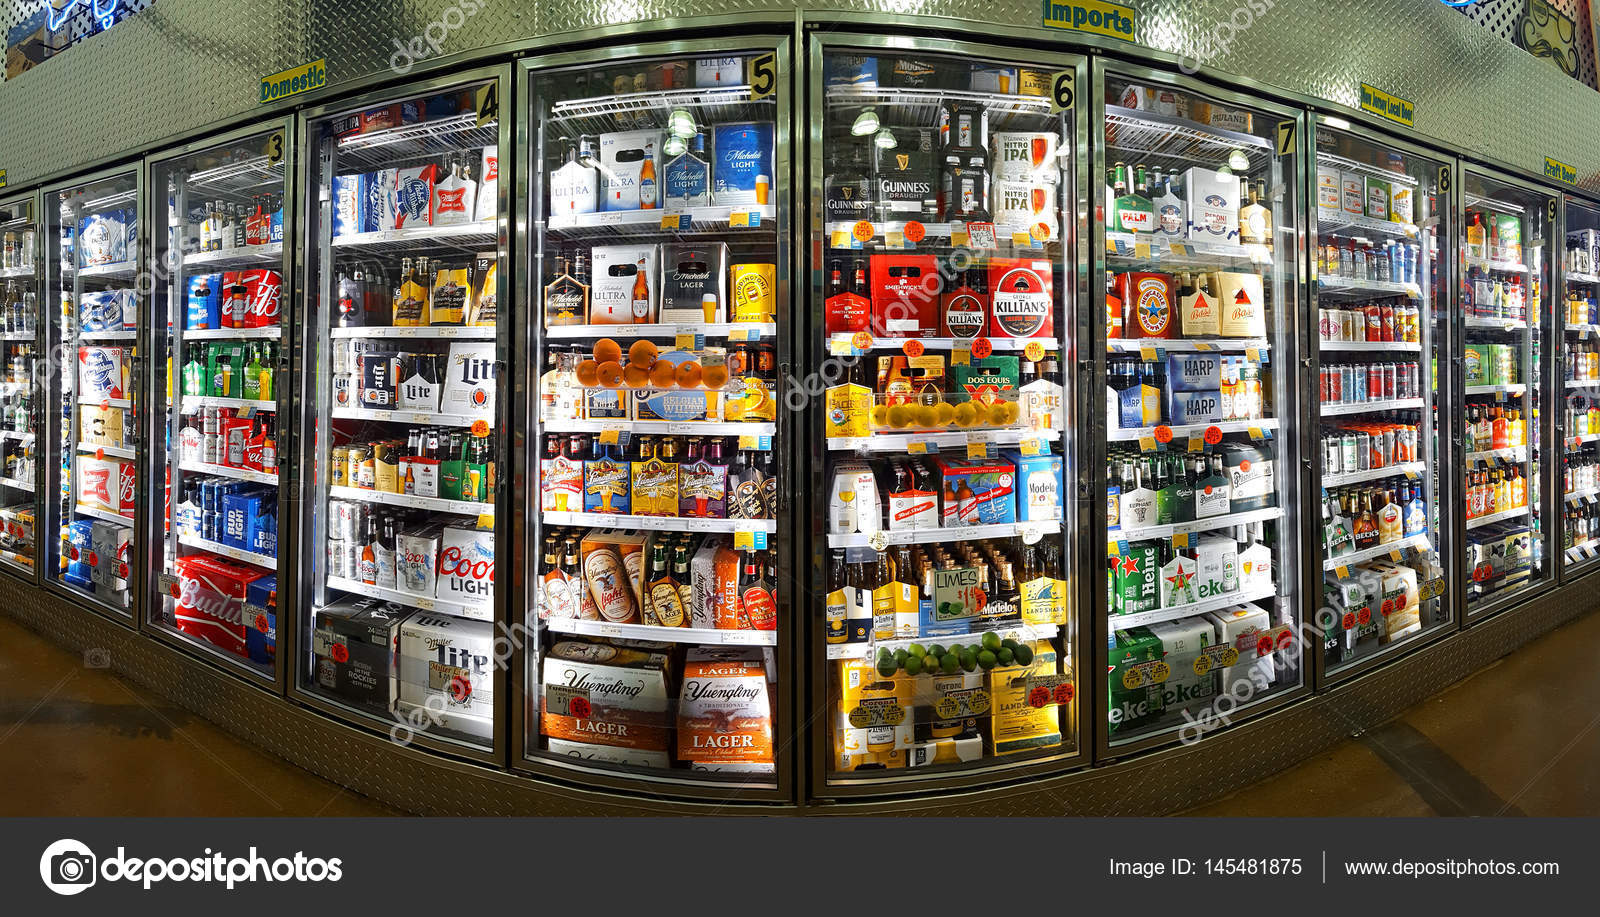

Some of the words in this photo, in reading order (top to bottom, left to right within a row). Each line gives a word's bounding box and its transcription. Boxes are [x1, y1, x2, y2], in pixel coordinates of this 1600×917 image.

[1045, 0, 1133, 35] Imports
[754, 53, 775, 94] 5
[260, 65, 325, 101] Domestic
[1053, 74, 1073, 108] 6
[479, 84, 499, 120] 4
[1279, 123, 1296, 154] 7
[269, 134, 283, 162] 3
[724, 149, 763, 161] Michelob
[1004, 149, 1029, 162] IPA
[667, 170, 705, 182] Michelob
[1545, 161, 1561, 180] Craft
[602, 178, 635, 188] ULTRA
[1439, 167, 1451, 192] 8
[881, 180, 930, 194] GUINNESS
[828, 199, 867, 210] GUINNESS
[1004, 198, 1029, 211] IPA
[1549, 199, 1557, 220] 9
[1122, 213, 1147, 222] PALM
[477, 259, 488, 268] 12
[673, 271, 712, 281] Michelob
[594, 292, 627, 300] ULTRA
[664, 298, 673, 306] 12
[1141, 290, 1166, 306] NEWCASTLE
[996, 301, 1047, 313] KILLIAN'S
[948, 315, 983, 324] KILLIAN'S
[881, 358, 889, 366] 12
[1184, 360, 1214, 376] HARP
[967, 376, 985, 384] DOS
[987, 376, 1011, 384] EQUIS
[406, 384, 431, 401] Lite
[663, 396, 705, 405] BELGIAN
[1186, 399, 1216, 416] HARP
[227, 510, 236, 535] BUD
[234, 508, 244, 541] LIGHT
[258, 531, 276, 544] BUD
[1355, 528, 1380, 541] BECK'S
[937, 570, 978, 588] LIMES
[726, 580, 736, 620] LAGER
[982, 602, 1013, 615] Modelo
[416, 616, 451, 628] Lite
[367, 626, 375, 634] 24
[1174, 640, 1185, 650] 12
[348, 670, 377, 686] ROCKIES
[698, 668, 748, 676] LAGER
[850, 672, 858, 680] 12
[564, 668, 645, 697] Yuengling
[684, 680, 764, 702] Yuengling
[1000, 702, 1027, 712] LANDS
[576, 719, 628, 737] LAGER
[693, 735, 755, 748] LAGER
